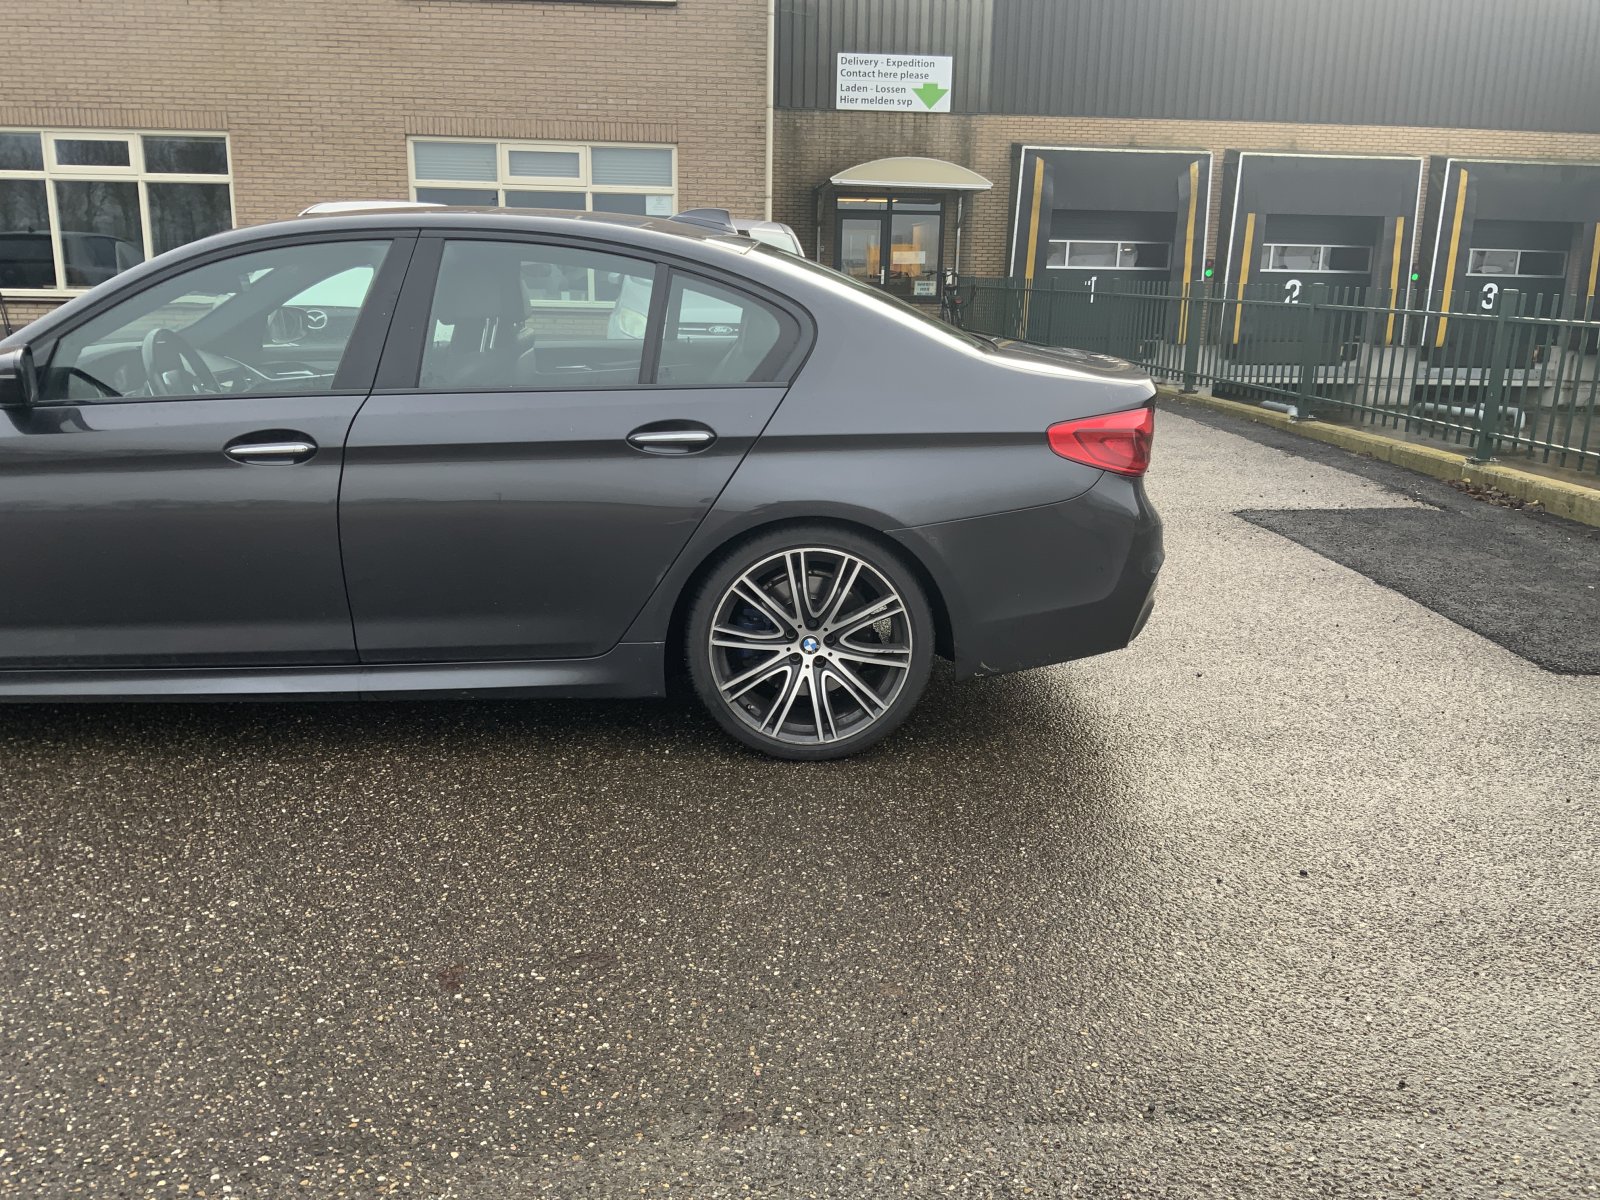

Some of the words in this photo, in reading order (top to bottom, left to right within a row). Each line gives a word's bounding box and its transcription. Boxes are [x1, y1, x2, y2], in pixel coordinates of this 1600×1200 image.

[840, 56, 879, 68] Delivery
[886, 58, 935, 69] Expedition
[840, 68, 876, 78] Contact
[877, 69, 898, 79] here
[900, 70, 930, 81] please
[840, 83, 868, 93] Laden
[875, 84, 907, 94] Lossen
[840, 95, 859, 104] Hier
[861, 95, 895, 105] melden
[896, 98, 913, 108] svp
[1084, 276, 1097, 304] 1
[1284, 279, 1302, 304] 2
[1481, 282, 1499, 310] 3
